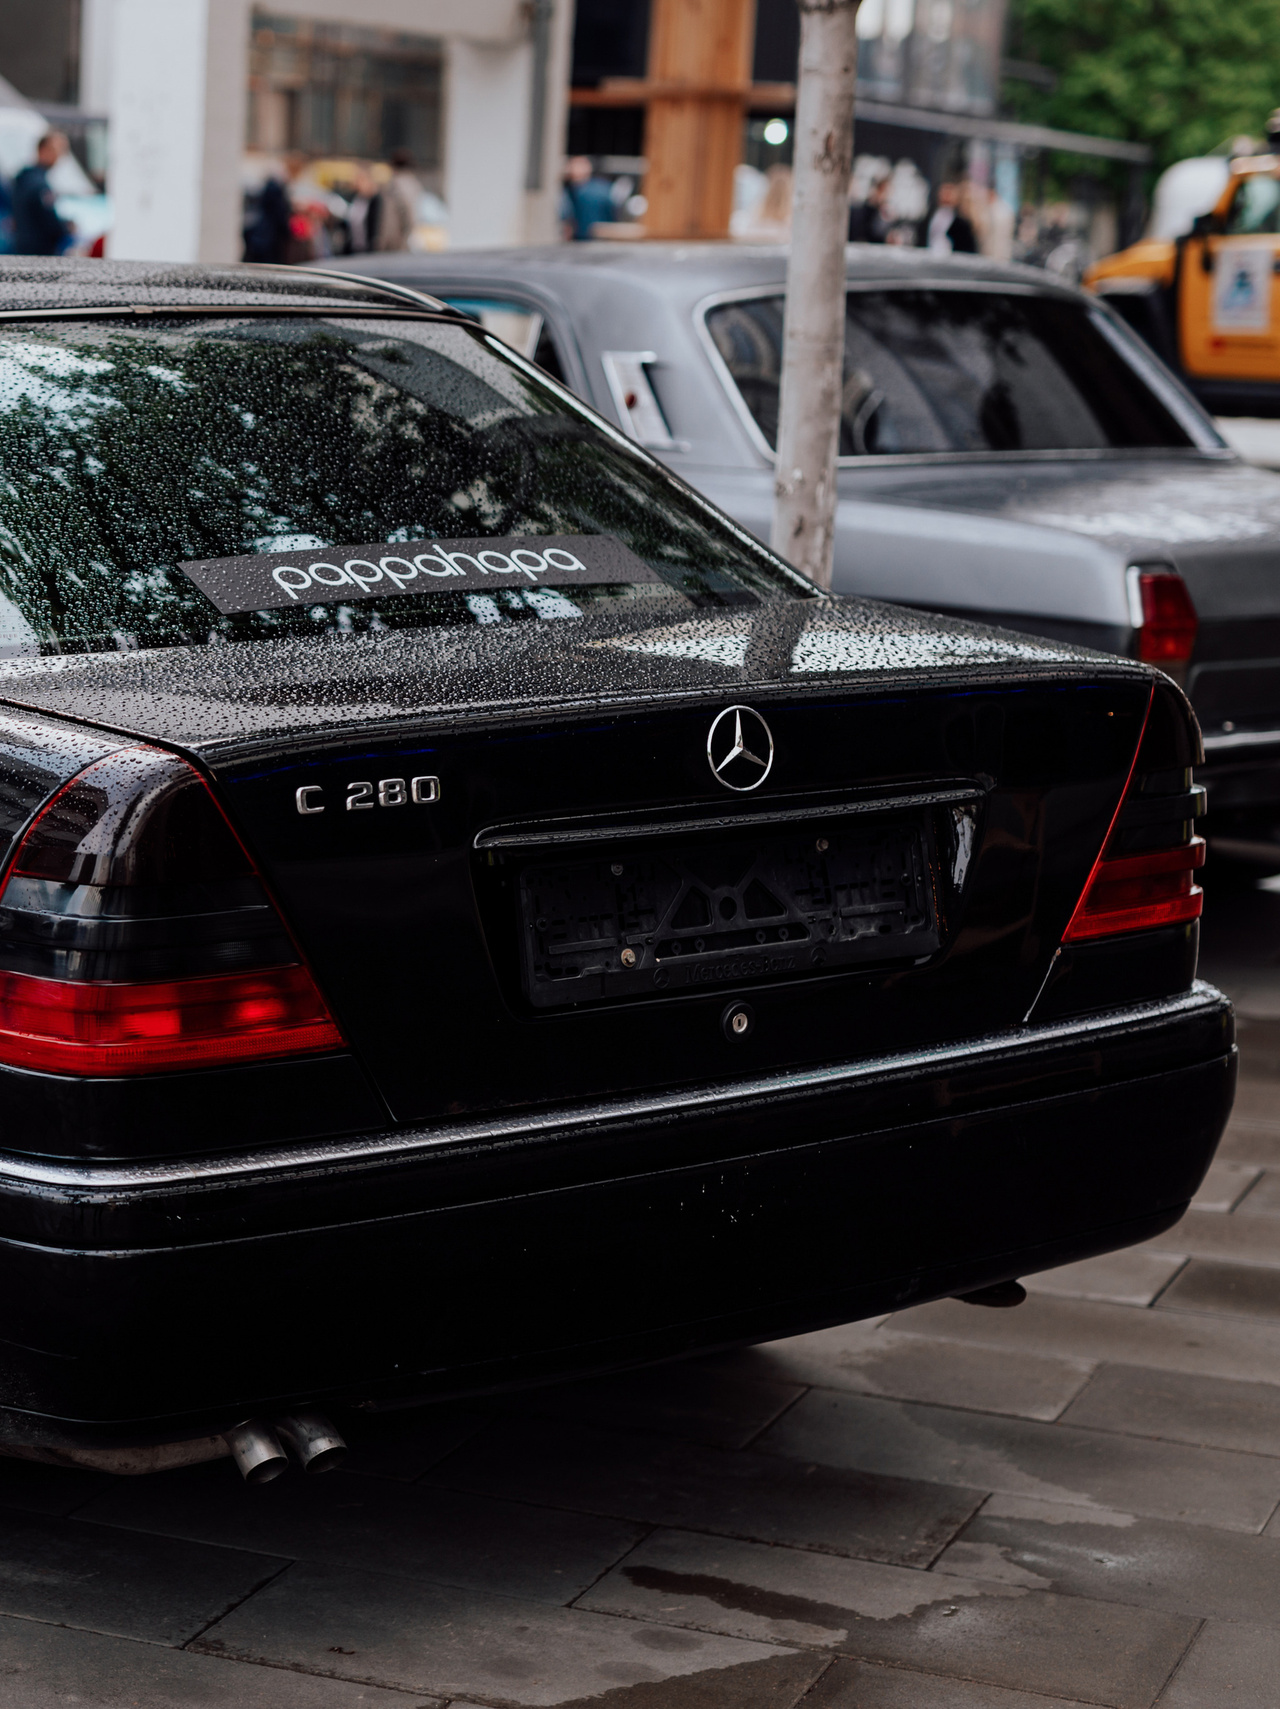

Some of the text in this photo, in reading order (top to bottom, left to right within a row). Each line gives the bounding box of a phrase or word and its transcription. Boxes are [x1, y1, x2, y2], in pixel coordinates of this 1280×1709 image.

[272, 544, 587, 600] pappahapa
[296, 776, 441, 814] C 280
[686, 956, 796, 983] Mercedes-Benz
